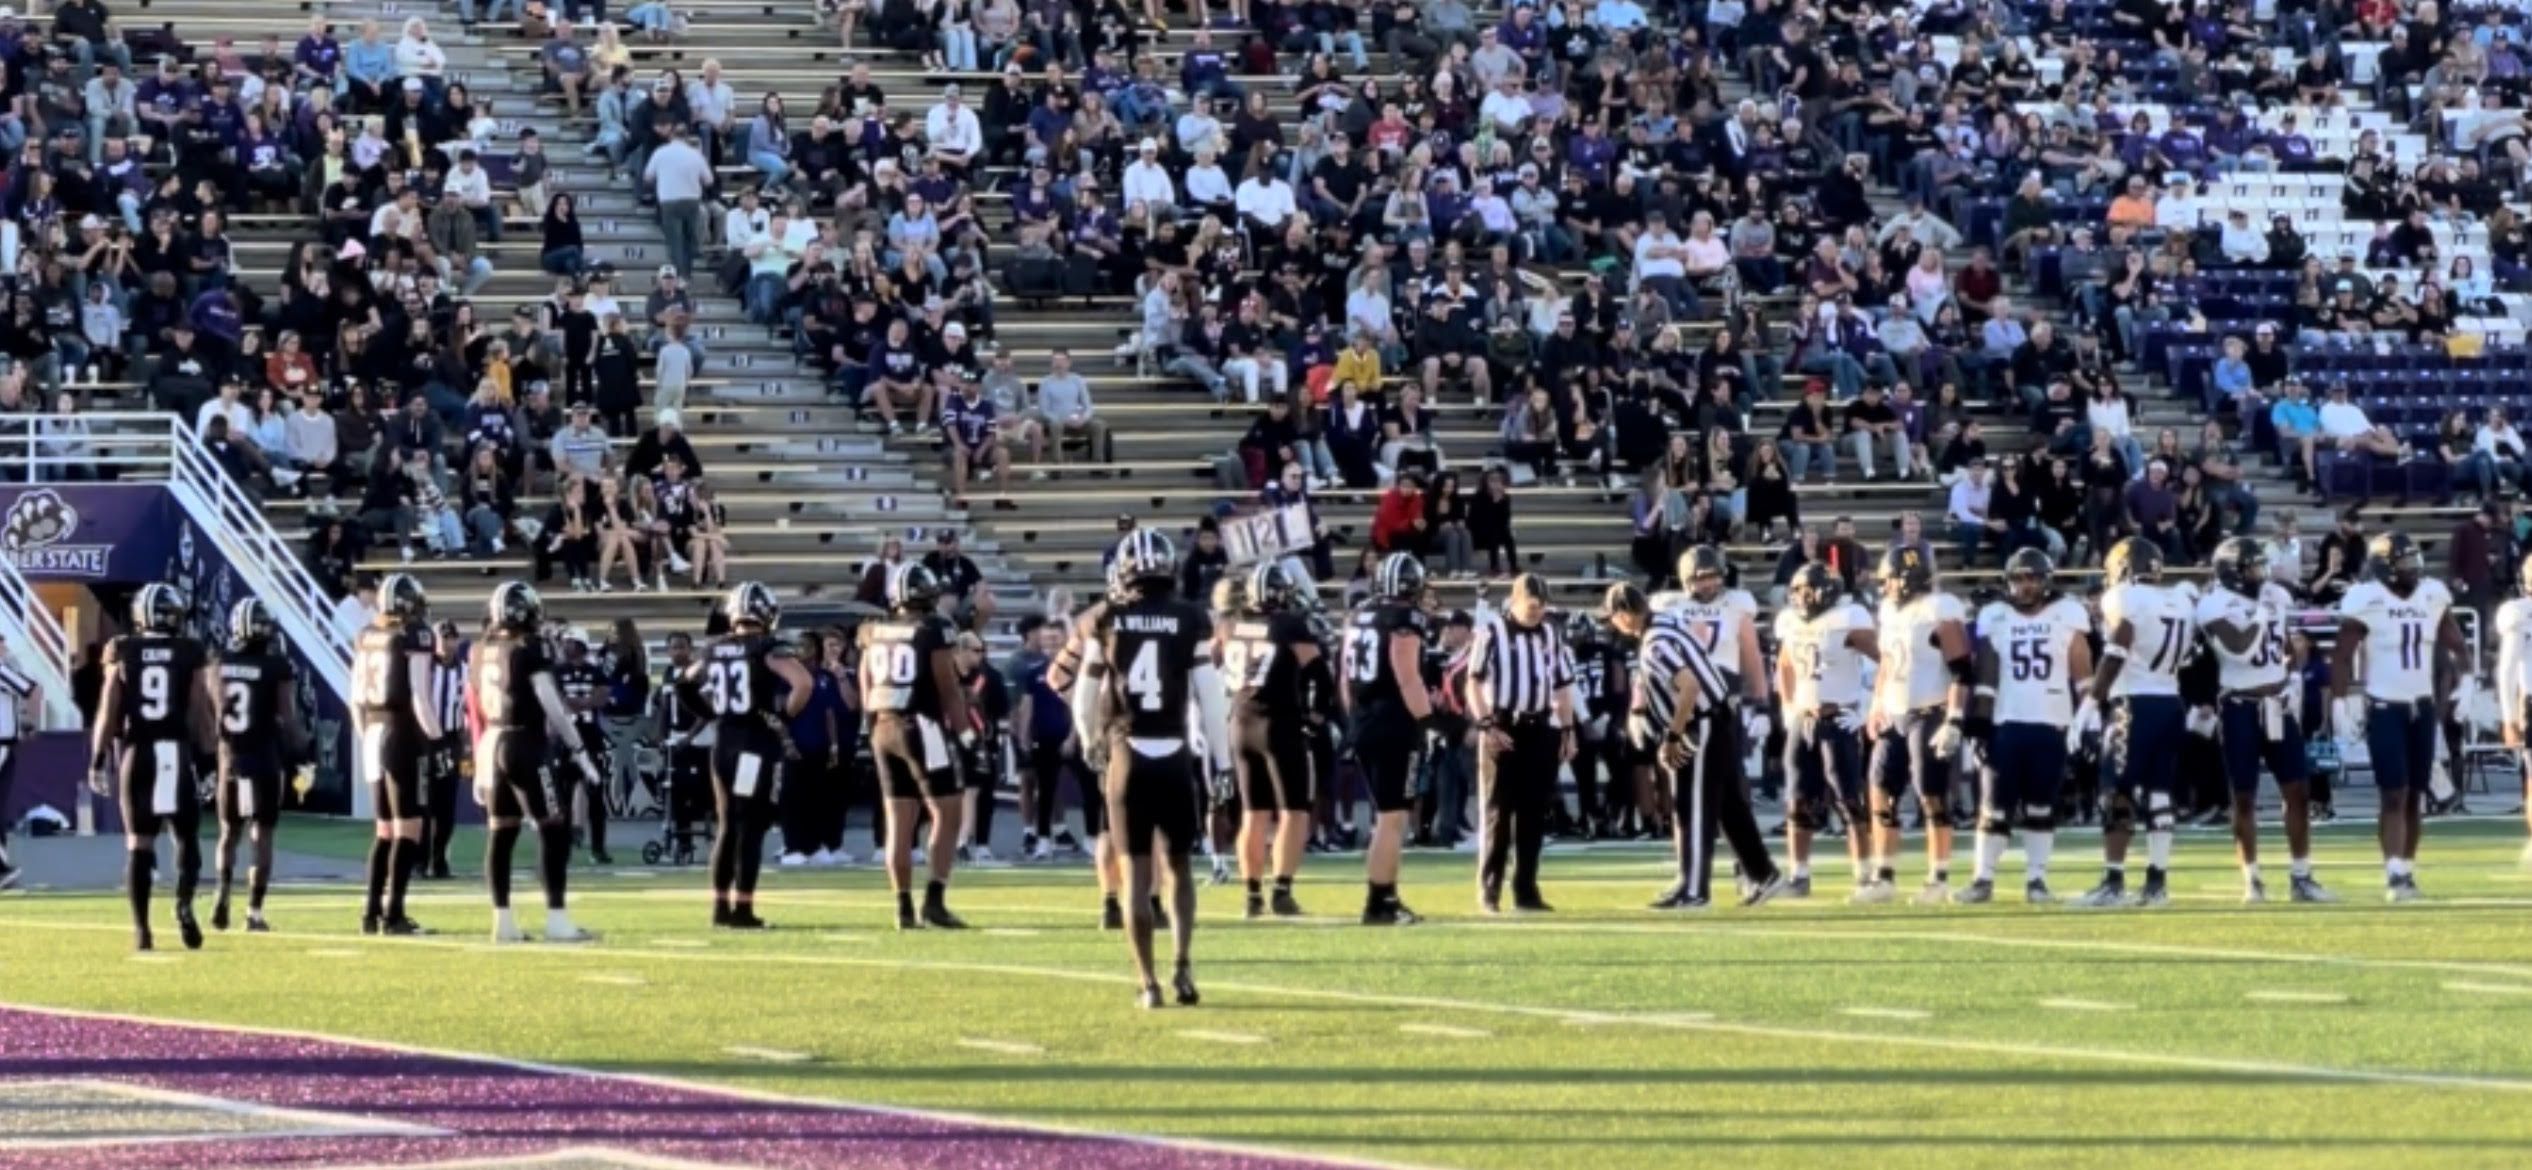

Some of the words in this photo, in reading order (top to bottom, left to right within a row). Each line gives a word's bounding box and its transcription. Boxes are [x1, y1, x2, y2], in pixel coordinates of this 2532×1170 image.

[47, 549, 102, 571] STATE
[1125, 614, 1178, 634] WILLIAMS
[2150, 617, 2185, 675] 71
[2401, 622, 2422, 670] 11
[1127, 639, 1163, 710] 4
[1223, 639, 1277, 692] 97
[2010, 637, 2054, 681] 55
[140, 665, 169, 721] 9
[223, 682, 249, 734] 3
